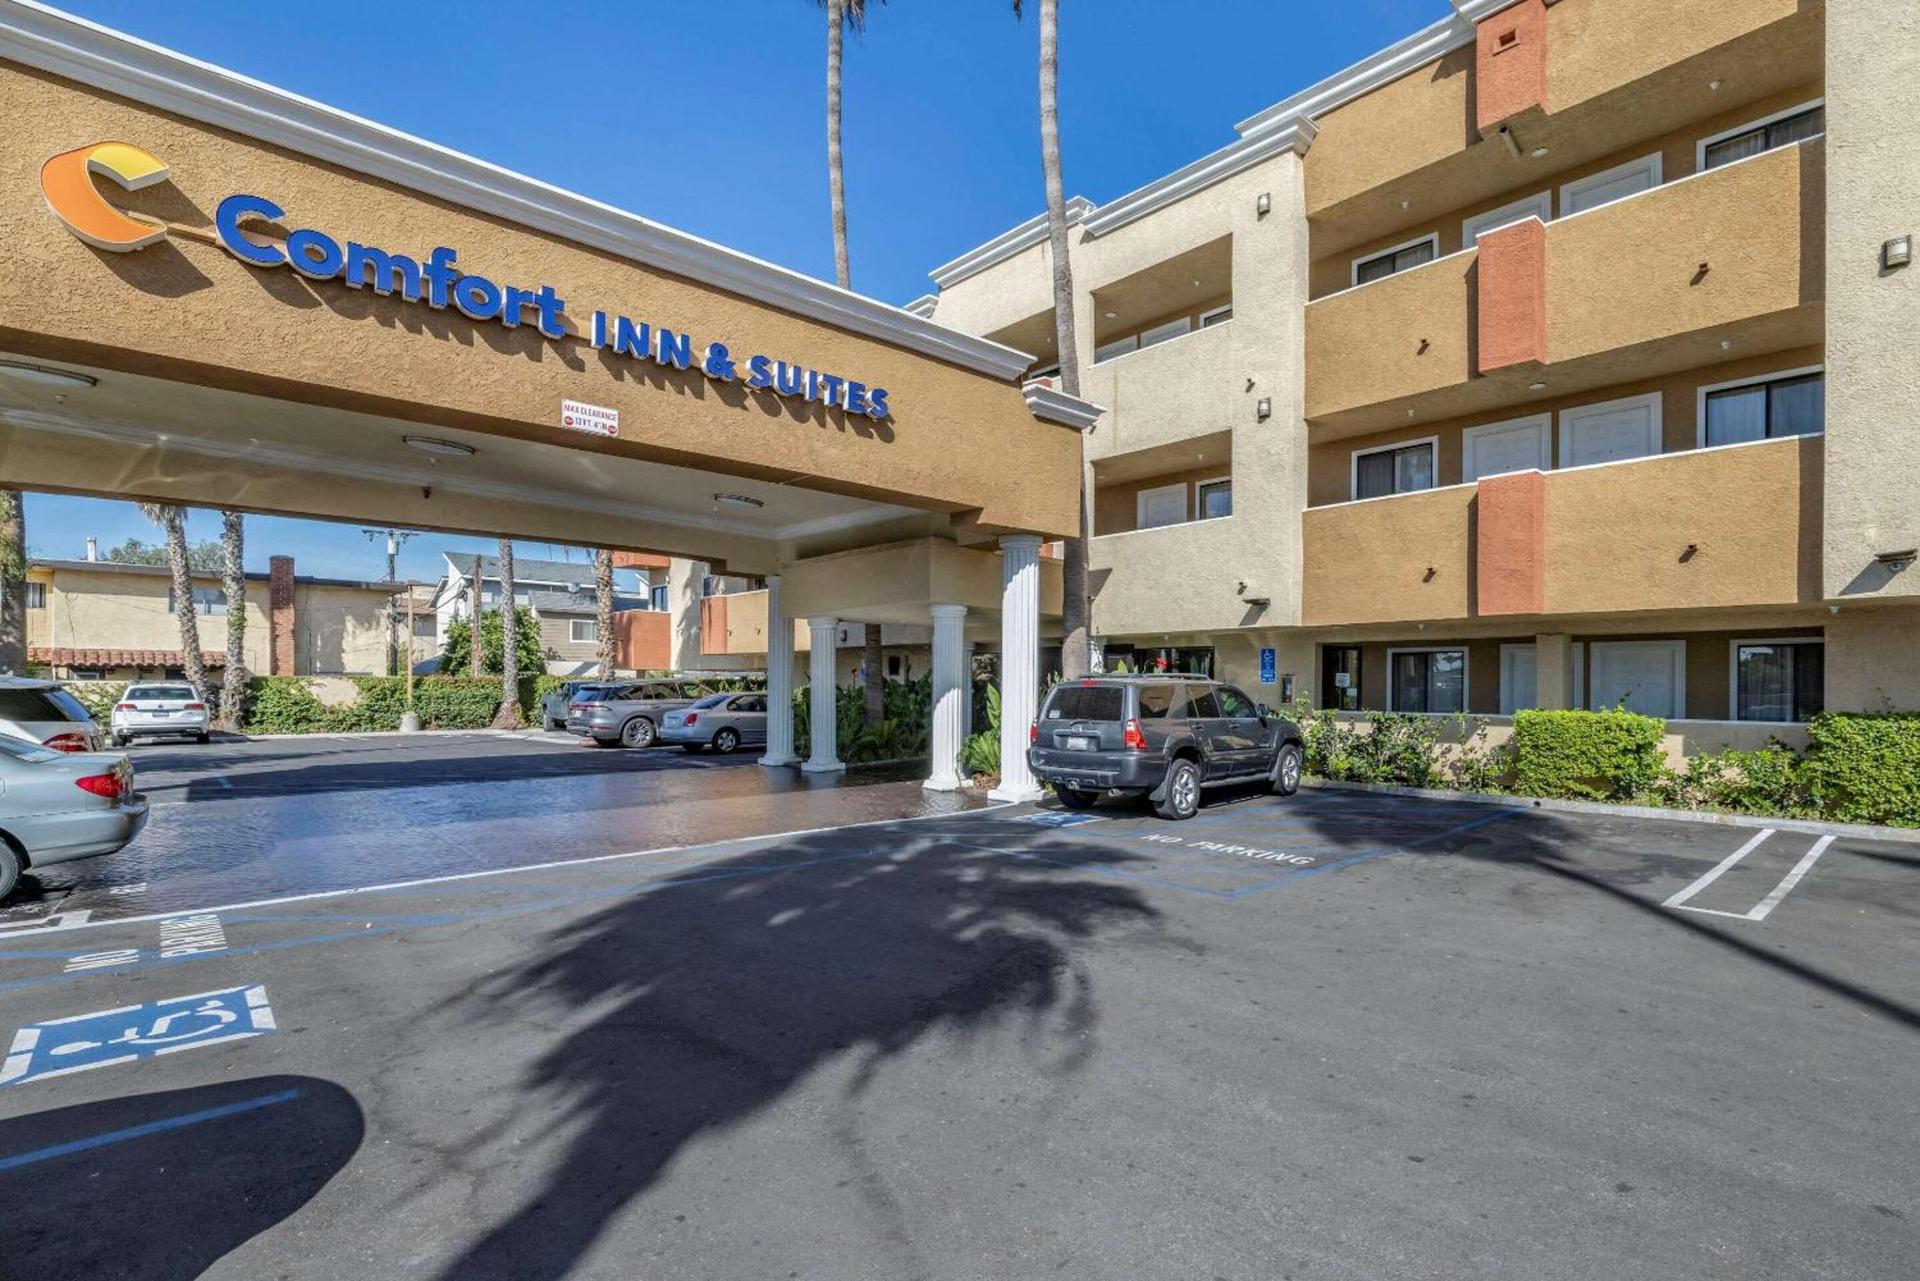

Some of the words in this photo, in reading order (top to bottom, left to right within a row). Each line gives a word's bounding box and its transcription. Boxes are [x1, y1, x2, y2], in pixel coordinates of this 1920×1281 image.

[216, 194, 567, 340] Comfort
[591, 311, 691, 370] INN
[702, 342, 737, 382] &
[746, 355, 889, 419] SUITES
[581, 406, 617, 421] CLEARANCE
[1140, 834, 1183, 843] NO
[1187, 841, 1315, 865] PARKING
